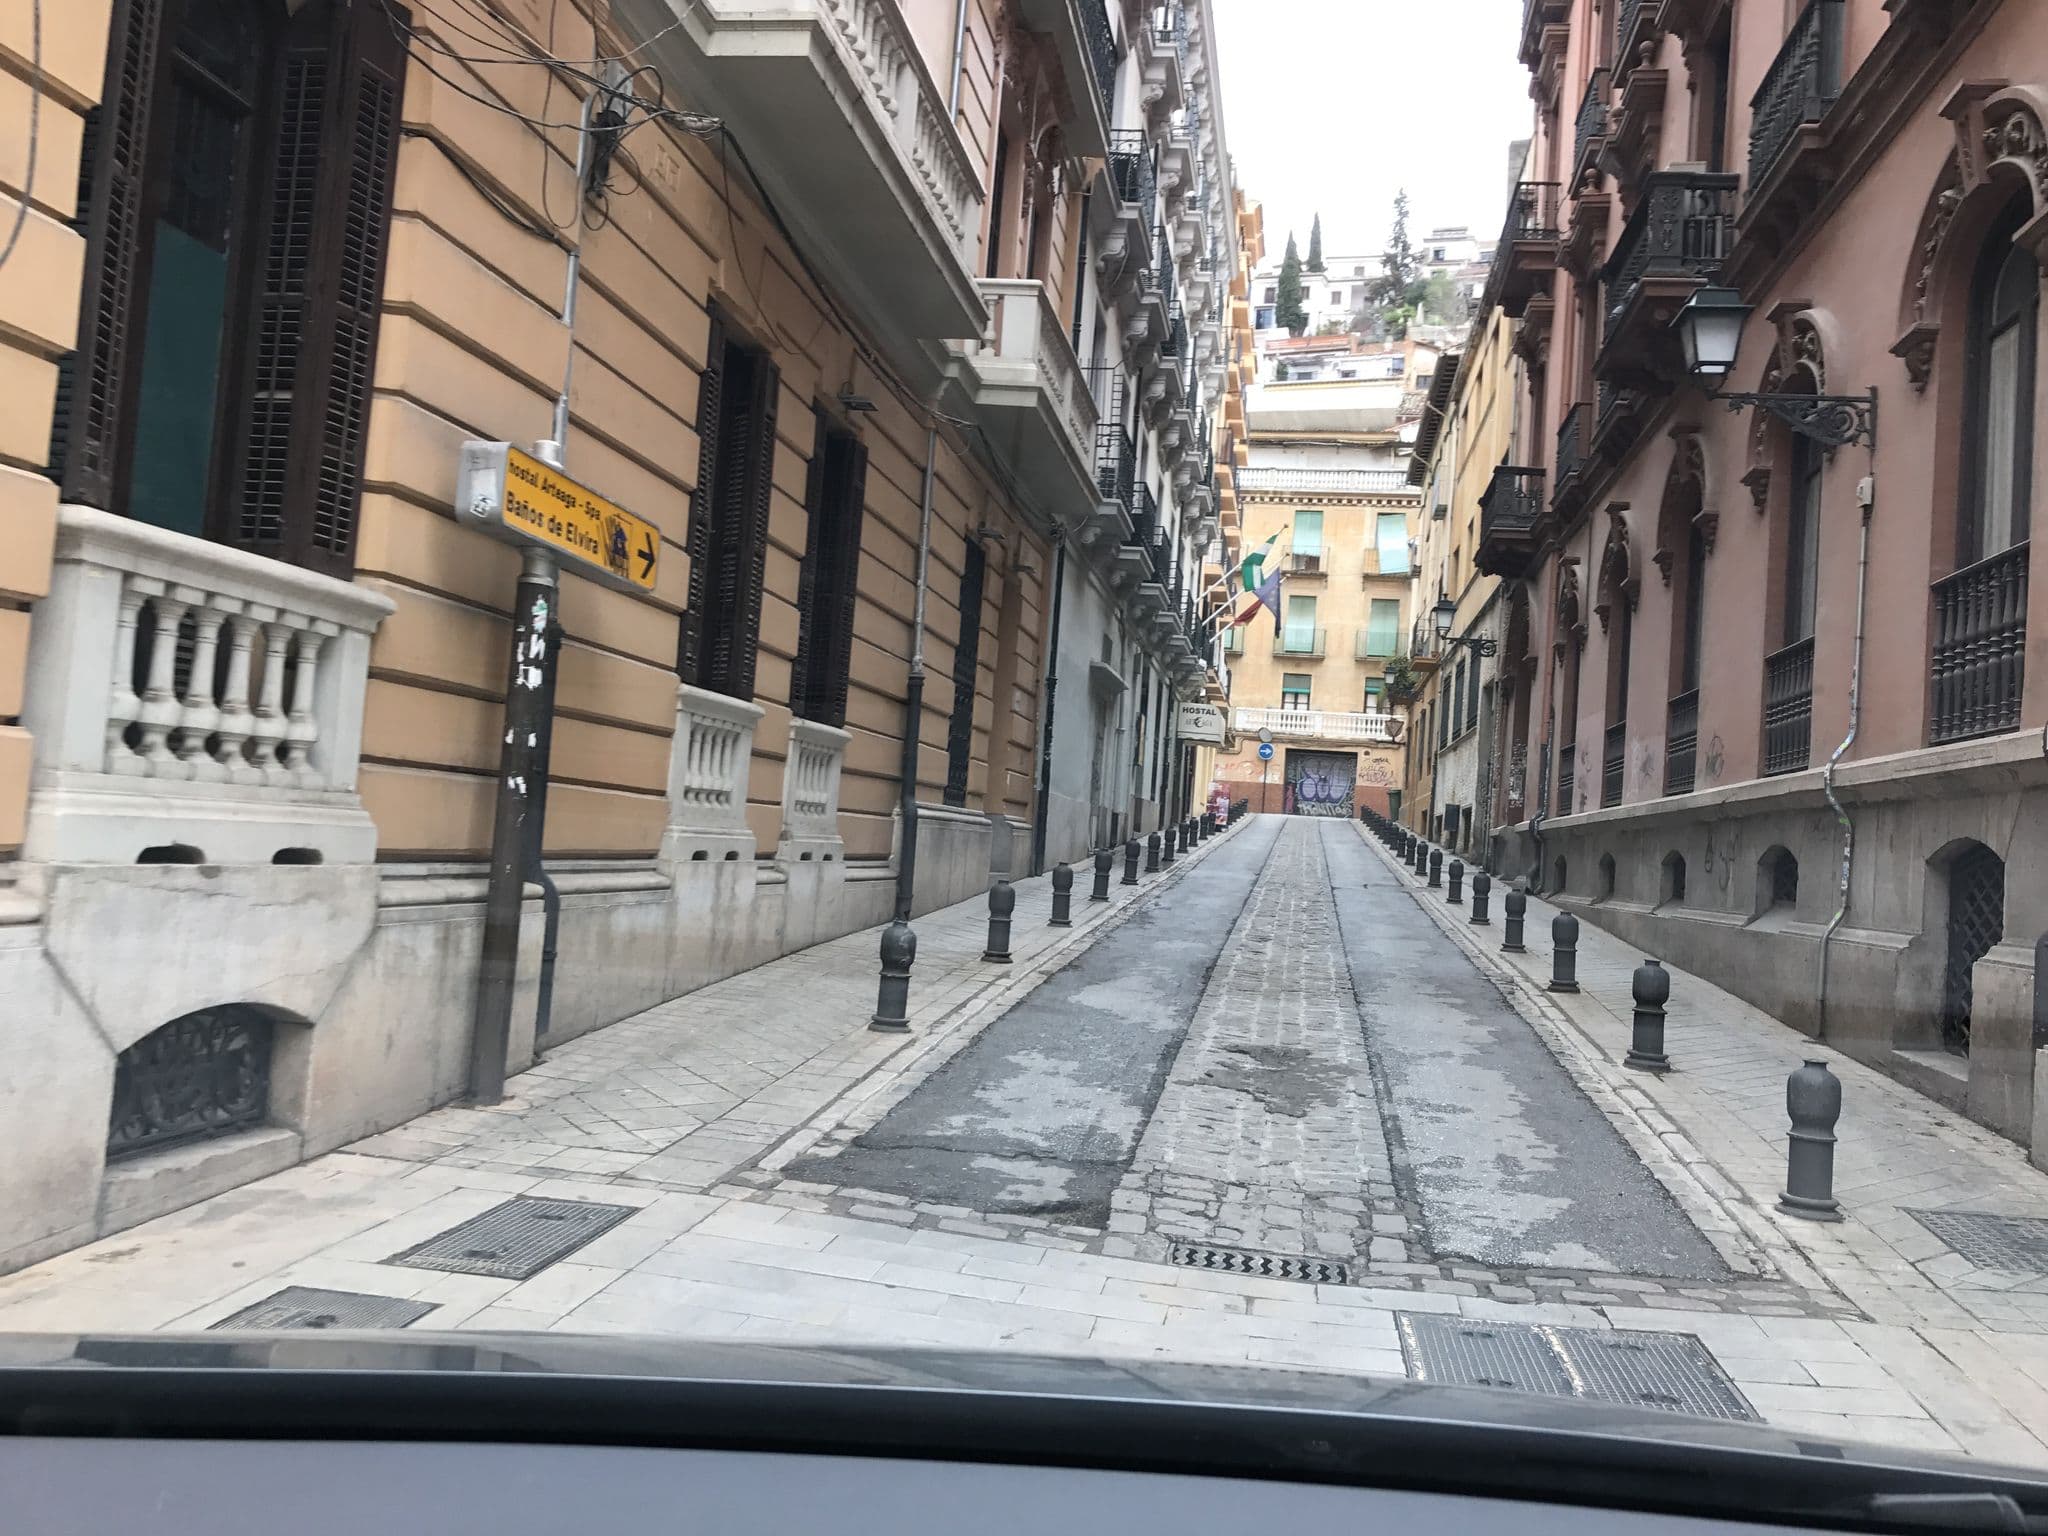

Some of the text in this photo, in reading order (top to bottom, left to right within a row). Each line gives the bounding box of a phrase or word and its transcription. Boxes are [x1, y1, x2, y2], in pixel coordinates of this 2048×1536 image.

[541, 477, 576, 508] Arteaga
[585, 501, 600, 520] Spa
[507, 491, 544, 528] Baños
[547, 515, 562, 537] de
[566, 522, 598, 554] Elvira
[1182, 706, 1217, 716] HOSTAL
